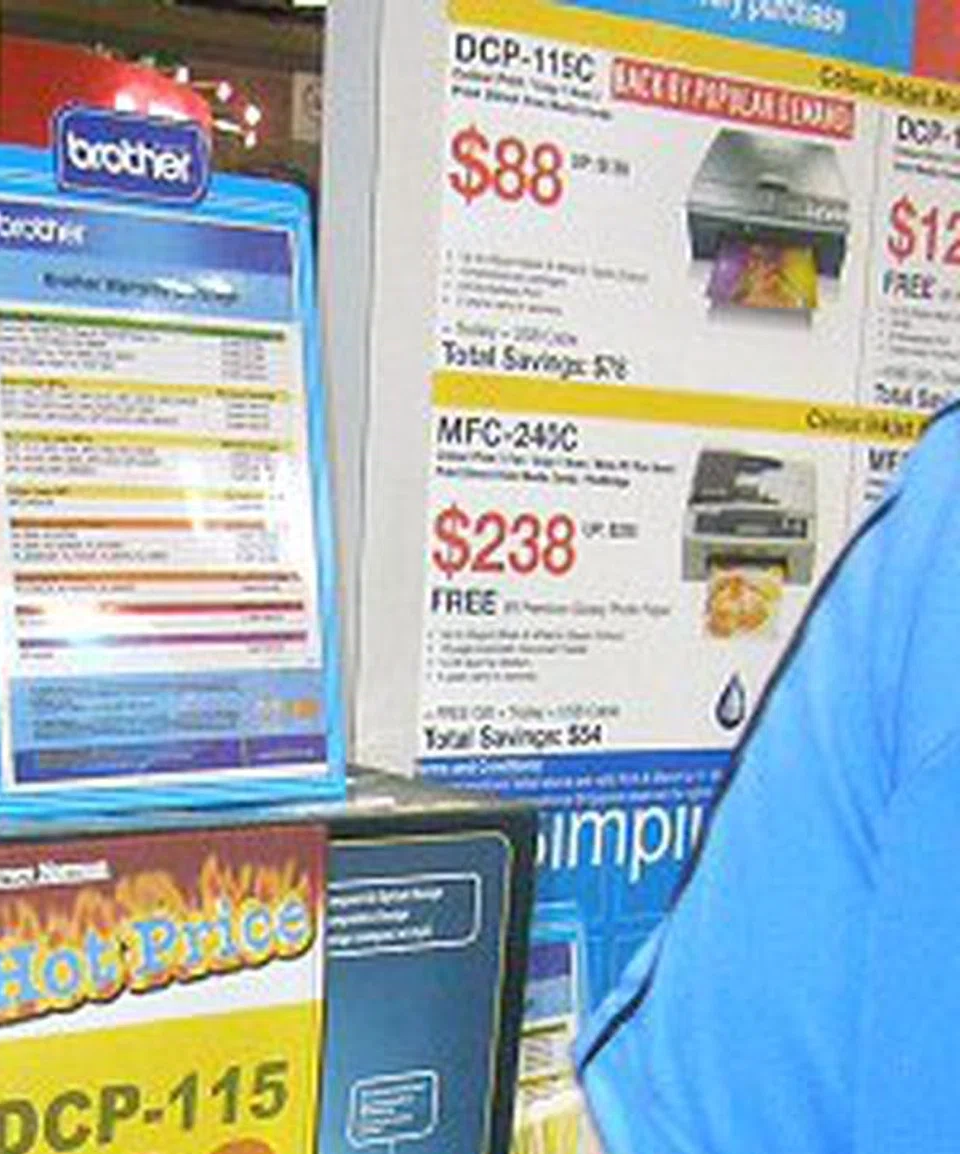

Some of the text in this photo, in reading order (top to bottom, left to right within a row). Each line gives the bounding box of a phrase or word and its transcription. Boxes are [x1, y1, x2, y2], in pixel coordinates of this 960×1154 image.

[455, 34, 595, 82] DCP-115C
[614, 60, 660, 97] BACK
[666, 72, 692, 104] BY
[66, 132, 191, 182] brother
[448, 124, 563, 206] $88
[882, 271, 934, 299] FREE
[442, 340, 496, 366] Total
[432, 503, 576, 580] $238
[430, 588, 497, 615] FREE
[424, 725, 475, 750] Total
[128, 892, 310, 975] Price
